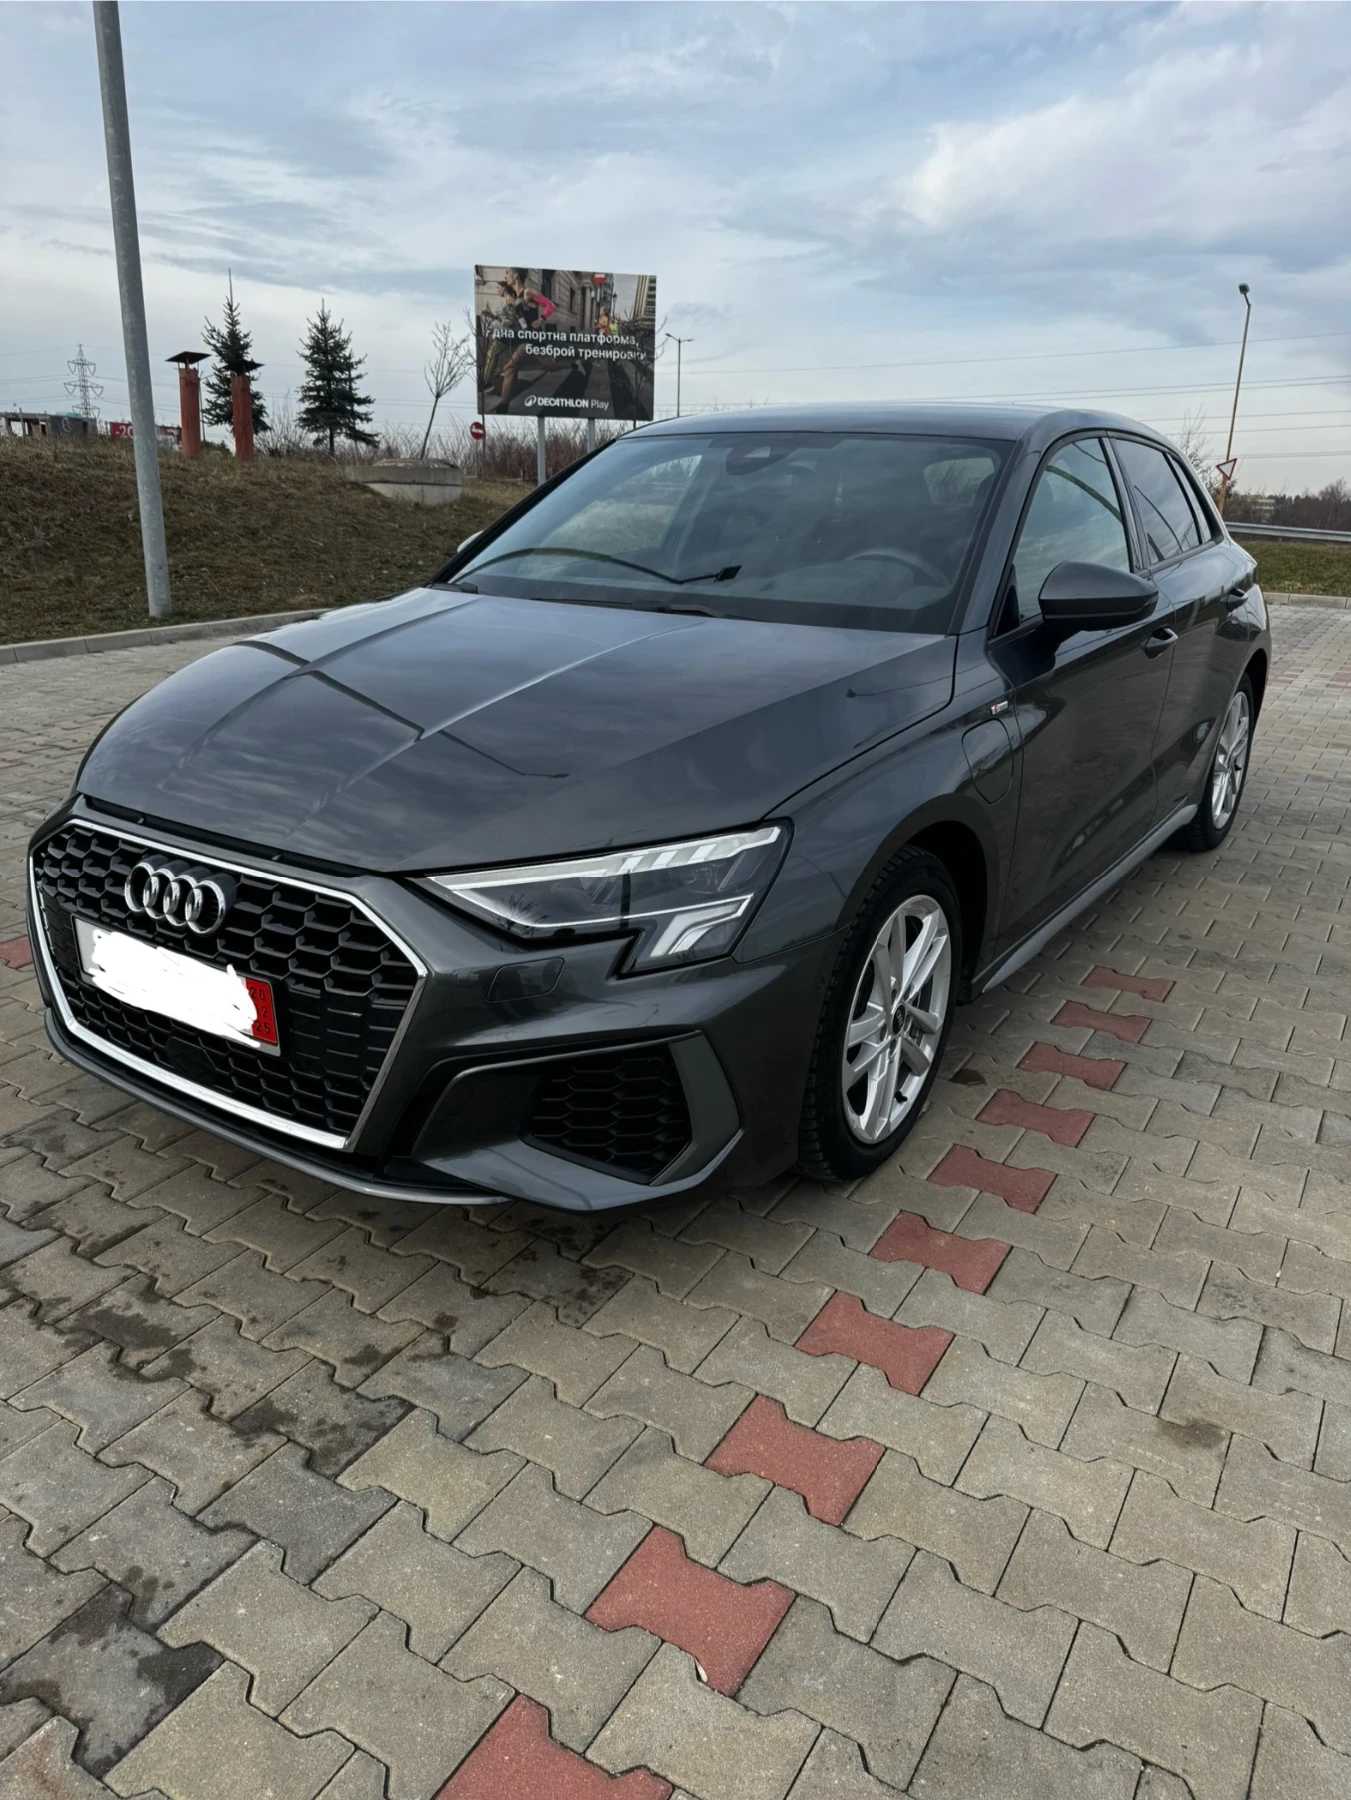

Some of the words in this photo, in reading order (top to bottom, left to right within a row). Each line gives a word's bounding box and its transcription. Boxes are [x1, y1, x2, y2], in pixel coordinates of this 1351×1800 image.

[517, 330, 567, 343] спортна
[569, 331, 639, 347] платформа,
[525, 343, 575, 358] безброй
[537, 397, 589, 409] DECATHLON
[590, 399, 610, 411] Play
[249, 986, 266, 1002] 20
[254, 1020, 270, 1034] 25
